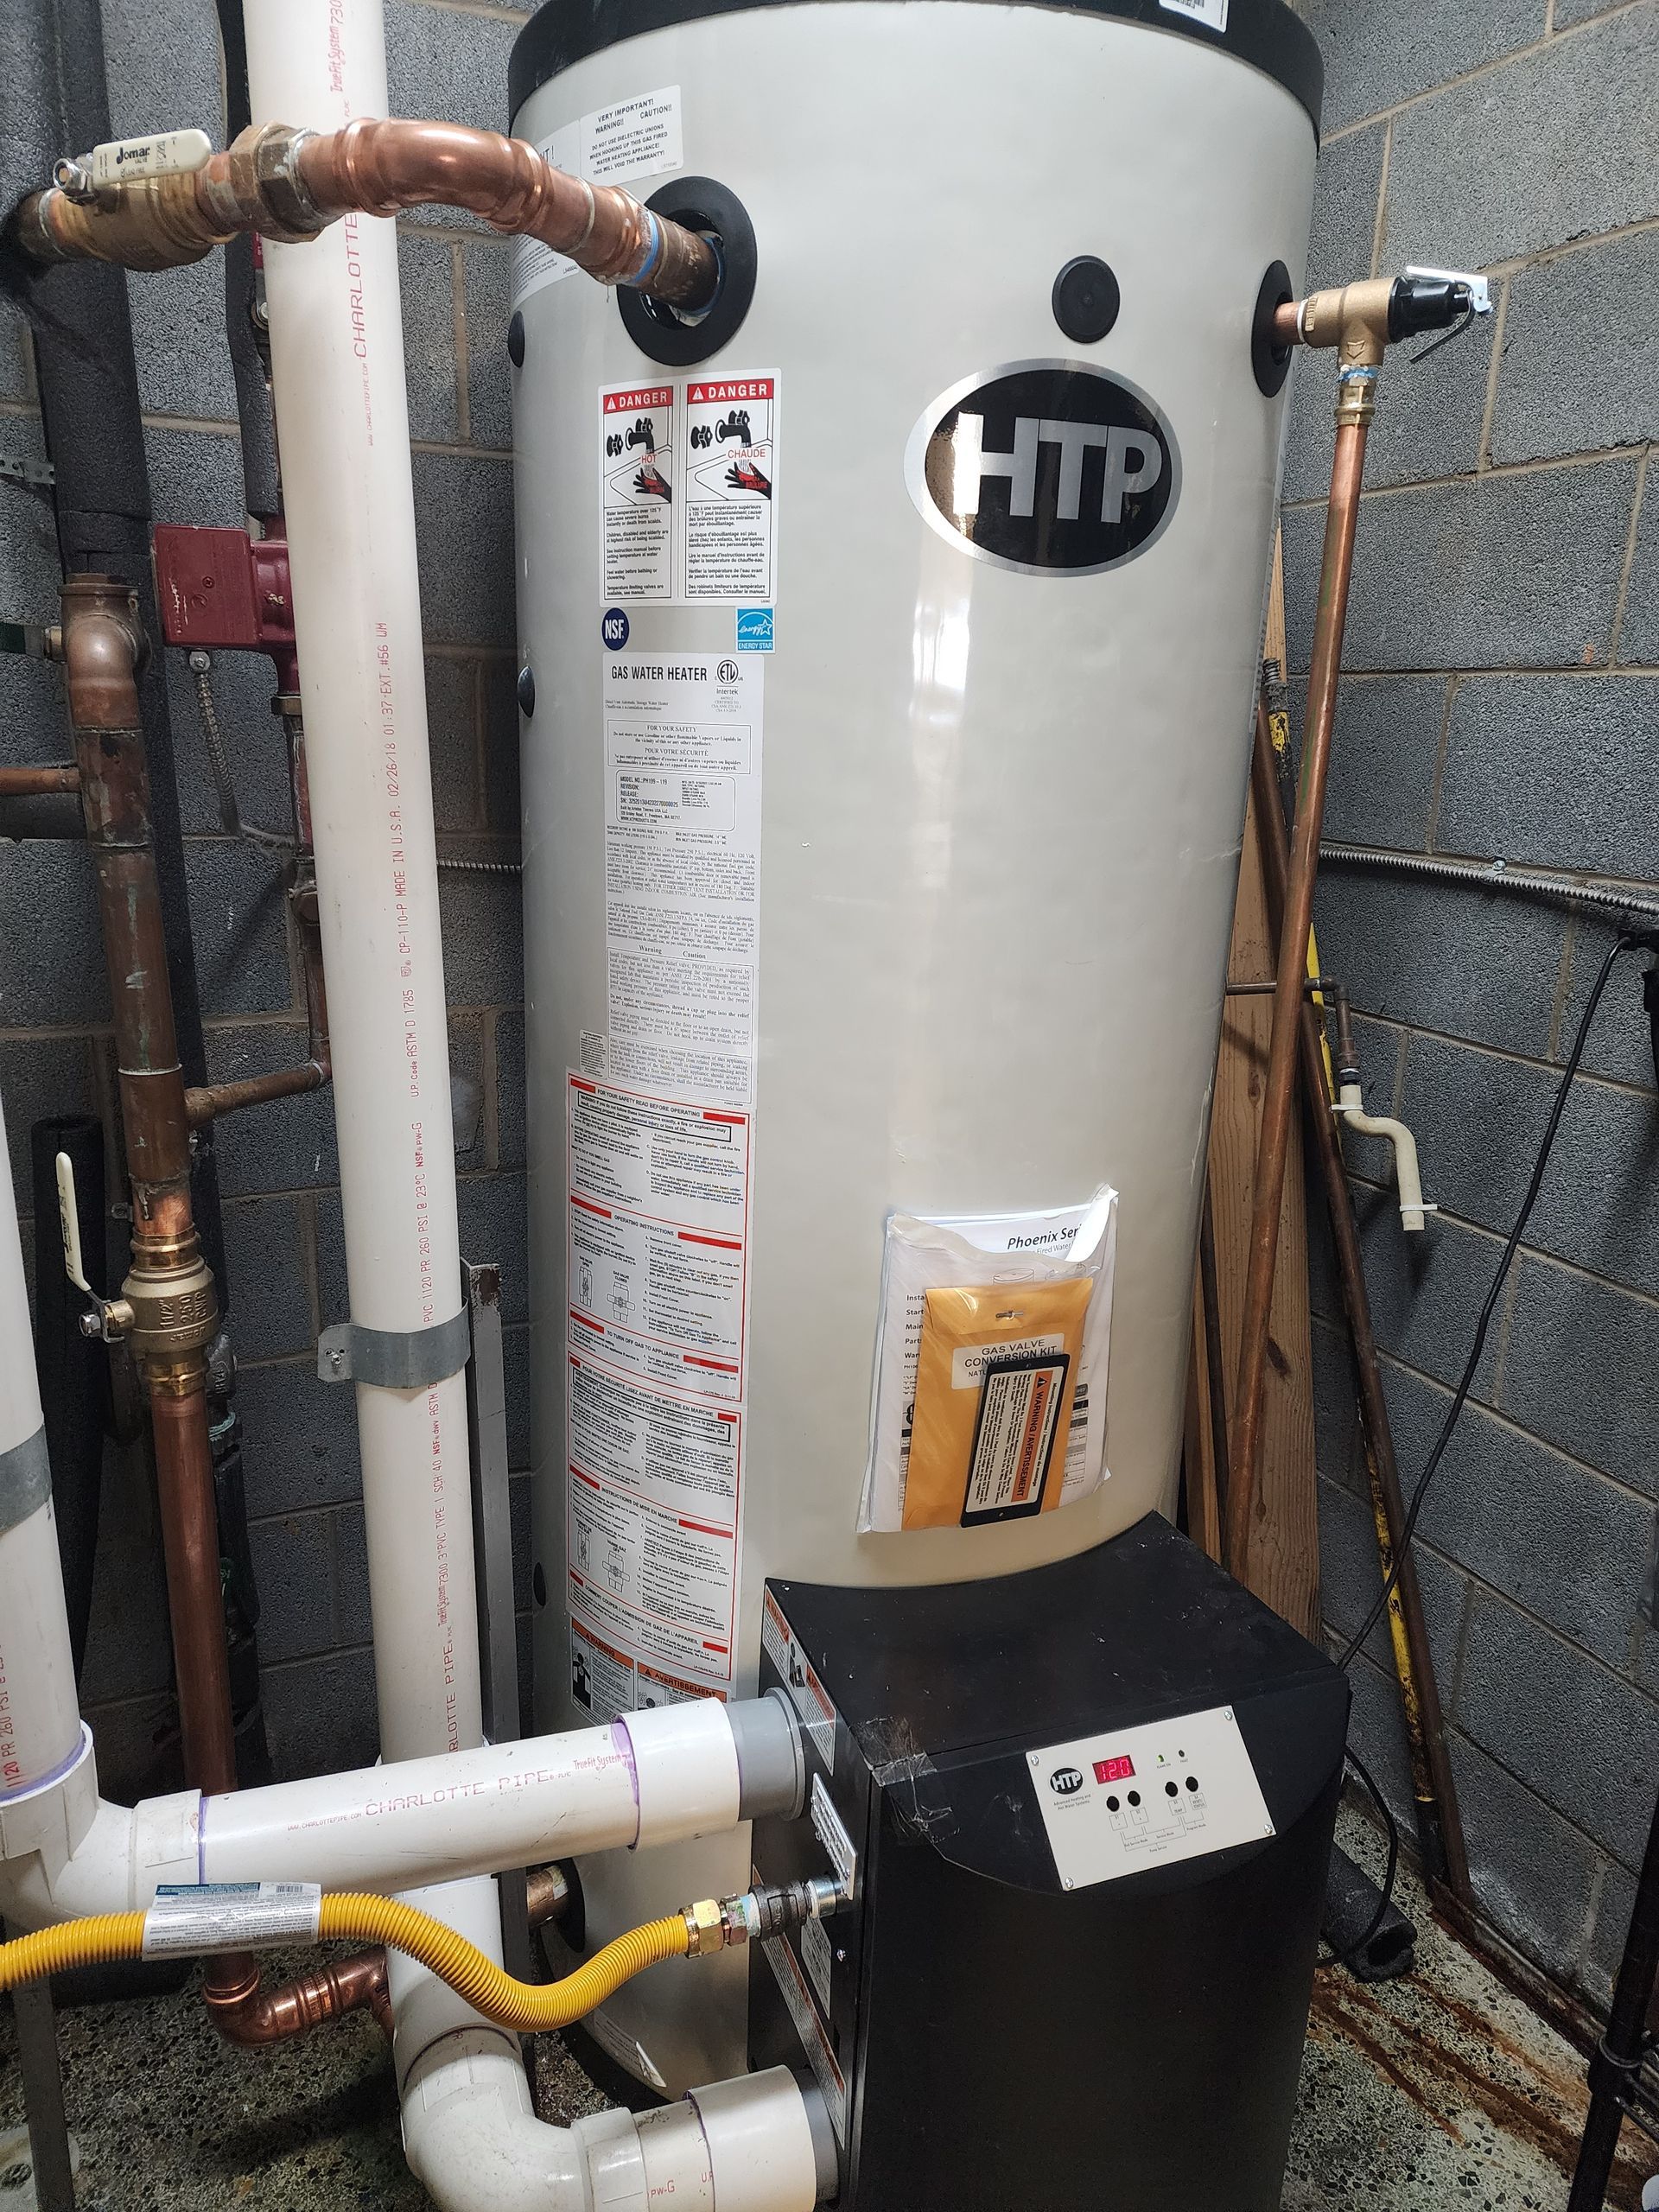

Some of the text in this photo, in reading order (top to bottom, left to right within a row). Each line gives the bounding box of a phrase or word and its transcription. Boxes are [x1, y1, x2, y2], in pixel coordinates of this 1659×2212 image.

[595, 104, 672, 134] WARNING!! CAUTION!!
[598, 99, 653, 123] VERY IMPORTANT!
[618, 130, 644, 141] DIELECTRIC
[645, 124, 664, 133] UNIONS
[602, 144, 622, 156] HOOKING
[612, 151, 631, 161] HEATING
[632, 143, 659, 154] APPLIANCE!
[637, 150, 664, 162] WARRANTY!
[345, 213, 366, 358] CHARLOTTE
[620, 391, 667, 408] DANGER
[709, 384, 767, 398] DANGER
[641, 454, 658, 464] HOT
[728, 448, 766, 458] CHAUDE
[953, 411, 1163, 524] HTP
[375, 622, 388, 638] WM
[605, 619, 624, 639] NSF
[612, 666, 707, 682] GAS WATER HEATER
[384, 742, 399, 797] 02/26/18
[389, 804, 403, 844] U.S.A.
[391, 850, 404, 863] IN
[393, 871, 407, 896] MADE
[397, 903, 411, 954] CP-110-P
[639, 944, 662, 954] Warning
[683, 950, 706, 959] Caution
[402, 989, 415, 1014] 1785
[405, 1033, 417, 1057] ASTM
[409, 1060, 418, 1079] Code
[597, 1088, 606, 1096] FOR
[606, 1091, 618, 1101] YOUR
[619, 1095, 635, 1106] SAFETY
[650, 1103, 670, 1112] BEFORE
[671, 1107, 701, 1117] OPERATING
[416, 1215, 429, 1232] PSI
[614, 1214, 674, 1236] OPERATING INSTRUCTIONS
[418, 1236, 430, 1255] 260
[1007, 1232, 1058, 1249] Phoenix
[1053, 1243, 1071, 1253] Water
[420, 1259, 431, 1272] PR
[419, 1276, 433, 1300] 1120
[194, 1291, 207, 1318] CWP
[423, 1304, 434, 1323] PVC
[613, 1332, 625, 1342] TURN
[625, 1338, 634, 1346] OFF
[634, 1341, 645, 1350] GAS
[652, 1347, 680, 1359] APPLIANCE
[964, 1345, 1057, 1367] CONVERSION KIT
[982, 1339, 1045, 1355] GAS VALVE
[582, 1365, 592, 1374] POUR
[592, 1369, 606, 1381] VOTRE
[626, 1385, 639, 1395] LISEZ
[639, 1389, 653, 1402] AVANT
[661, 1398, 682, 1410] METTRE
[690, 1406, 714, 1417] MARCHE
[428, 1393, 440, 1416] ASTM
[1029, 1391, 1045, 1432] WARNING
[431, 1420, 440, 1434] dwv
[431, 1459, 442, 1471] 40
[1016, 1437, 1035, 1497] AVERTISSEMENT
[434, 1506, 446, 1528] TYPE
[437, 1563, 449, 1585] 7300
[591, 1636, 615, 1657] WARNING
[442, 1644, 454, 1684] PIPE
[655, 1670, 716, 1699] AVERTISSEMENT
[0, 1716, 25, 1787] 1120 PR 260
[574, 1753, 622, 1771] TrueFit System
[1101, 1758, 1130, 1780] 120
[1052, 1771, 1081, 1791] HTP
[365, 1783, 486, 1816] CHARLOTTE
[499, 1770, 550, 1790] PIPE
[651, 2180, 675, 2199] PW-G
